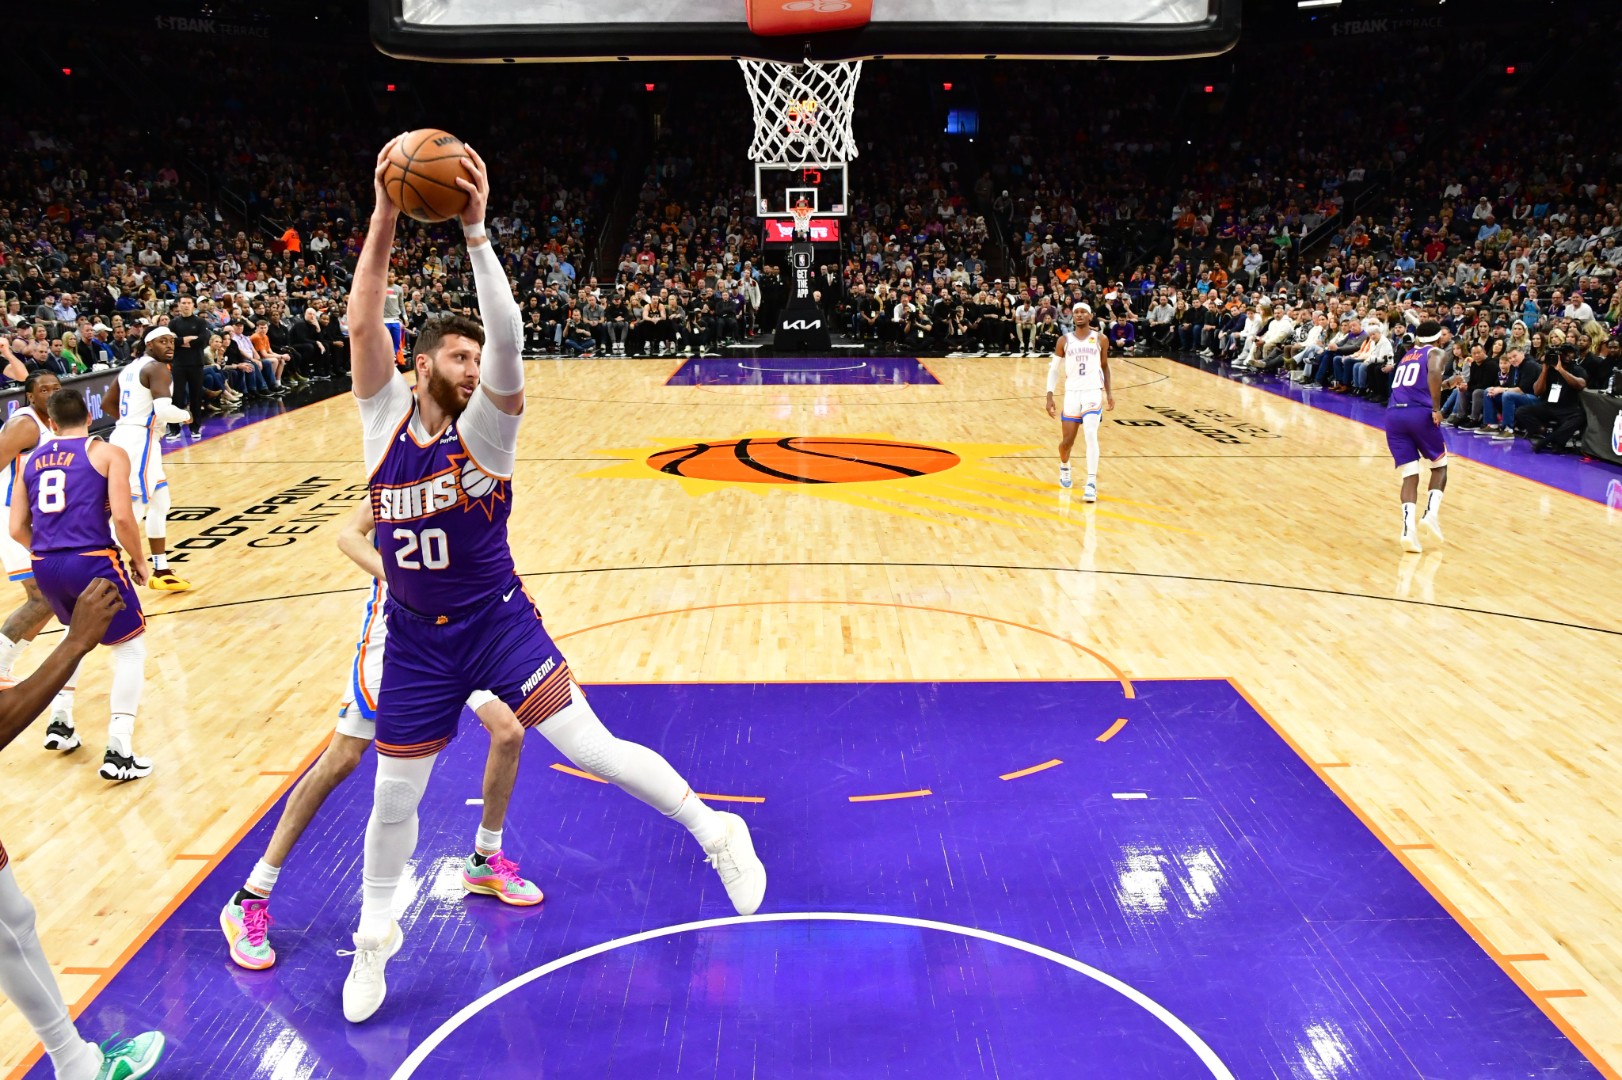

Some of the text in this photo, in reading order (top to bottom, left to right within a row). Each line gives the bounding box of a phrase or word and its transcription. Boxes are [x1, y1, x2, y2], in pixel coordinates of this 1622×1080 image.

[796, 269, 808, 279] GET
[796, 279, 808, 288] THE
[797, 288, 809, 299] APP
[783, 319, 821, 330] KIA
[1078, 362, 1086, 376] 2
[1391, 362, 1420, 389] 00
[121, 390, 130, 417] 5
[439, 434, 458, 445] PayPal
[35, 452, 75, 471] ALLEN
[38, 468, 67, 514] 8
[393, 528, 450, 570] 20
[520, 655, 556, 697] PHOENIX
